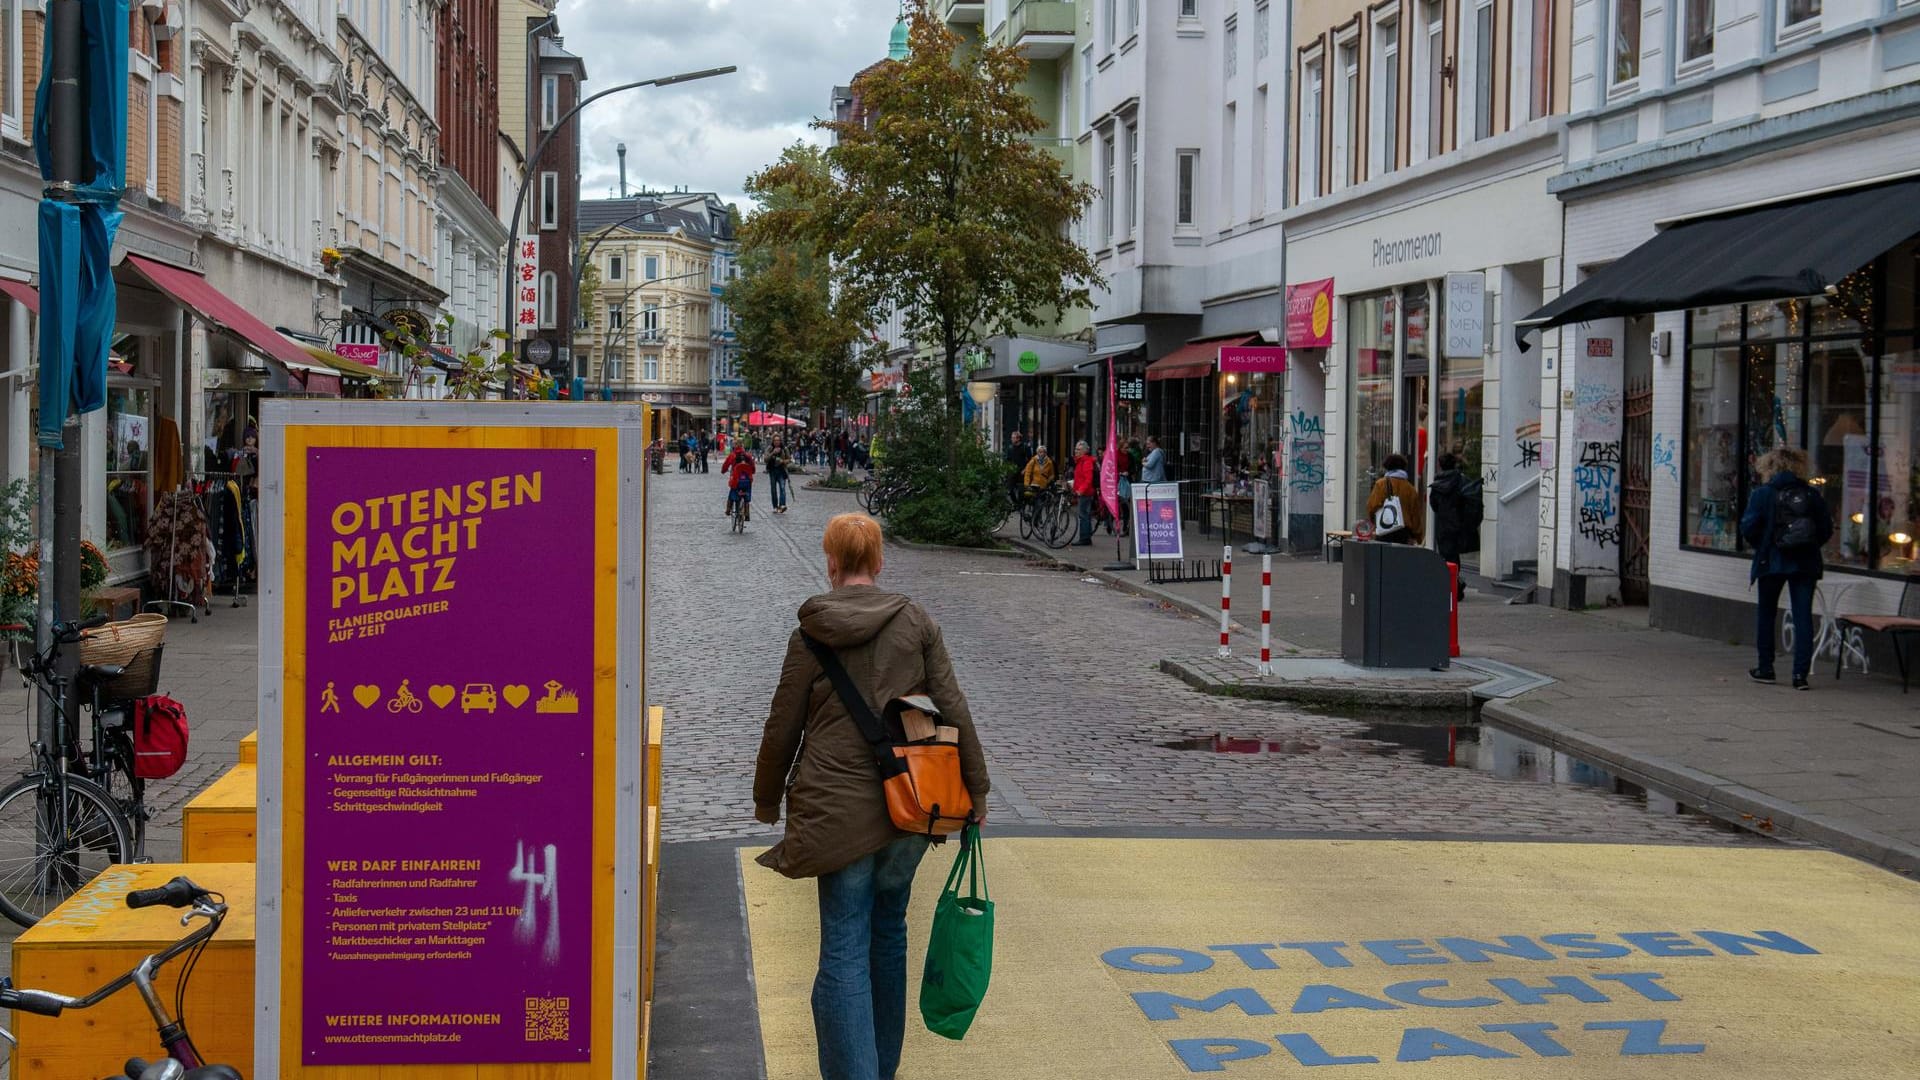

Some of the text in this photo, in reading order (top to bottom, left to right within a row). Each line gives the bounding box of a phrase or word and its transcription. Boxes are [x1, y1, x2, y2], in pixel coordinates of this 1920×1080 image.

[1373, 232, 1441, 268] Phenomenon
[1451, 282, 1478, 294] PHE
[1450, 301, 1472, 312] NO
[1450, 319, 1481, 330] MEN
[1449, 336, 1472, 348] ON
[1127, 382, 1135, 399] FÜR
[331, 471, 541, 536] OTTENSEN
[332, 517, 482, 572] MACHT
[332, 557, 456, 609] PLATZ
[329, 600, 449, 631] FLANIERQUARTIER
[328, 623, 386, 643] AUF ZEIT
[328, 755, 442, 766] ALLGEMEIN GILT:
[334, 773, 542, 784] Vorrang für Fußgängerinnen und Fußgänger
[334, 787, 478, 799] Gegenseitige Rücksichtnahme
[333, 801, 443, 813] Schrittgeschwindigkeit
[327, 860, 358, 871] WER
[362, 860, 397, 871] DARF
[332, 879, 478, 888] Radfahrerinnen und Radfahrer
[333, 893, 357, 903] Taxis
[332, 907, 407, 917] Anlieferverkehr
[409, 907, 453, 916] zwischen
[455, 907, 468, 916] 23
[470, 907, 489, 916] und
[491, 907, 504, 916] 11
[332, 922, 378, 931] Personen
[380, 922, 395, 931] mit
[397, 922, 440, 933] privatem
[332, 936, 485, 946] Marktbeschicker an Markttagen
[426, 952, 472, 960] erforderlich
[1101, 931, 1821, 974] OTTENSEN
[1130, 972, 1683, 1021] MACHT
[325, 1014, 501, 1026] WEITERE INFORMATIONEN
[325, 1033, 461, 1044] www.ottensenmachtplatz.de
[1167, 1019, 1706, 1073] PLATZ
